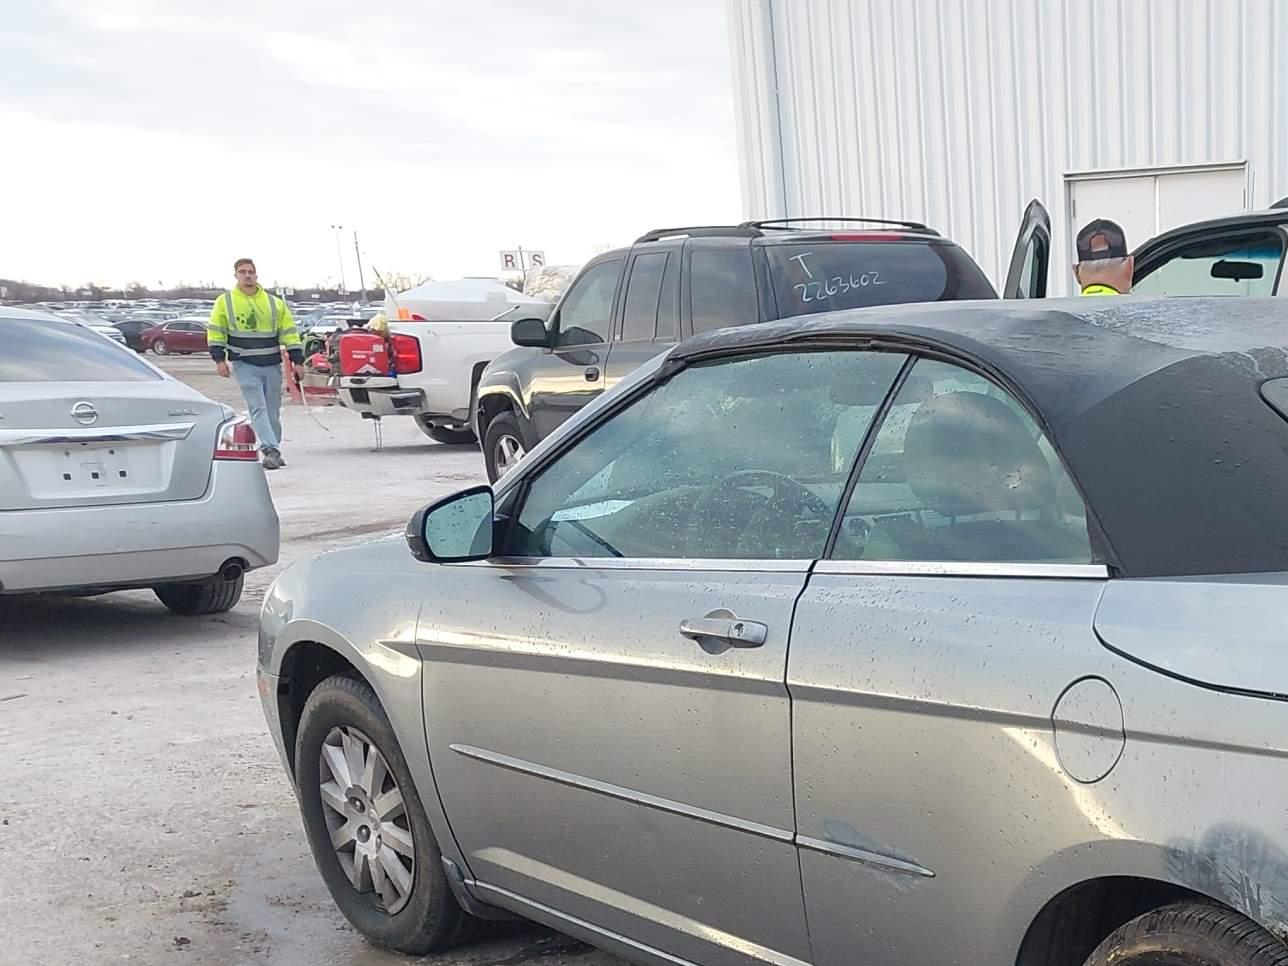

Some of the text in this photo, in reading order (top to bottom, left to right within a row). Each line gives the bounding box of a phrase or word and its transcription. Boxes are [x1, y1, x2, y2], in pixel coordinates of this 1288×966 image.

[504, 254, 515, 268] R
[532, 254, 543, 266] S
[789, 252, 813, 279] T
[793, 271, 887, 302] 2263602
